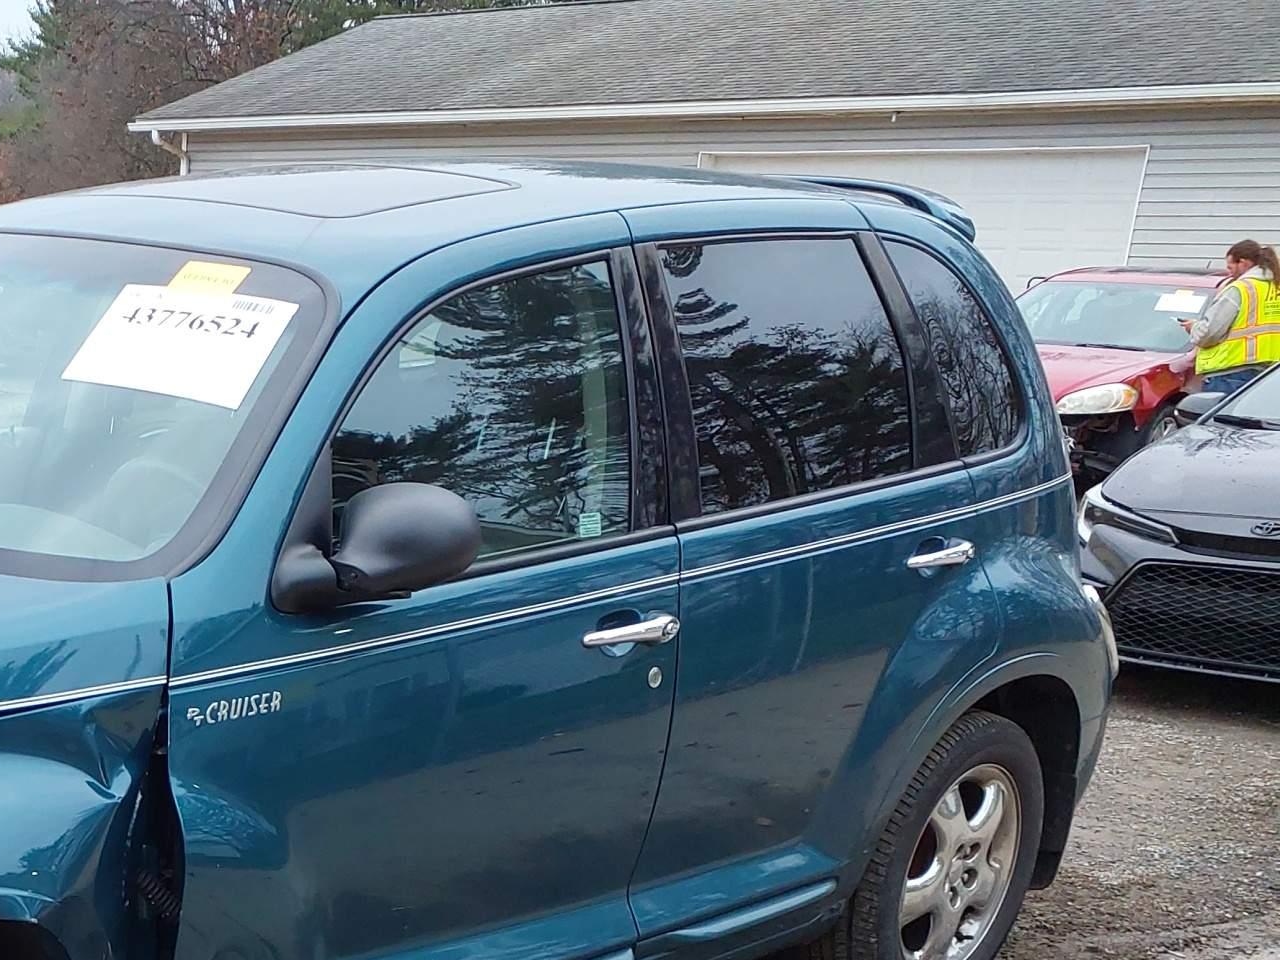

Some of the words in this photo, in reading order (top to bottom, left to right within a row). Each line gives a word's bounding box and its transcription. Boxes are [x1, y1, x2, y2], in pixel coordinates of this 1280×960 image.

[122, 307, 260, 338] 43776524
[186, 707, 205, 726] PT
[206, 691, 282, 723] CRUISER
